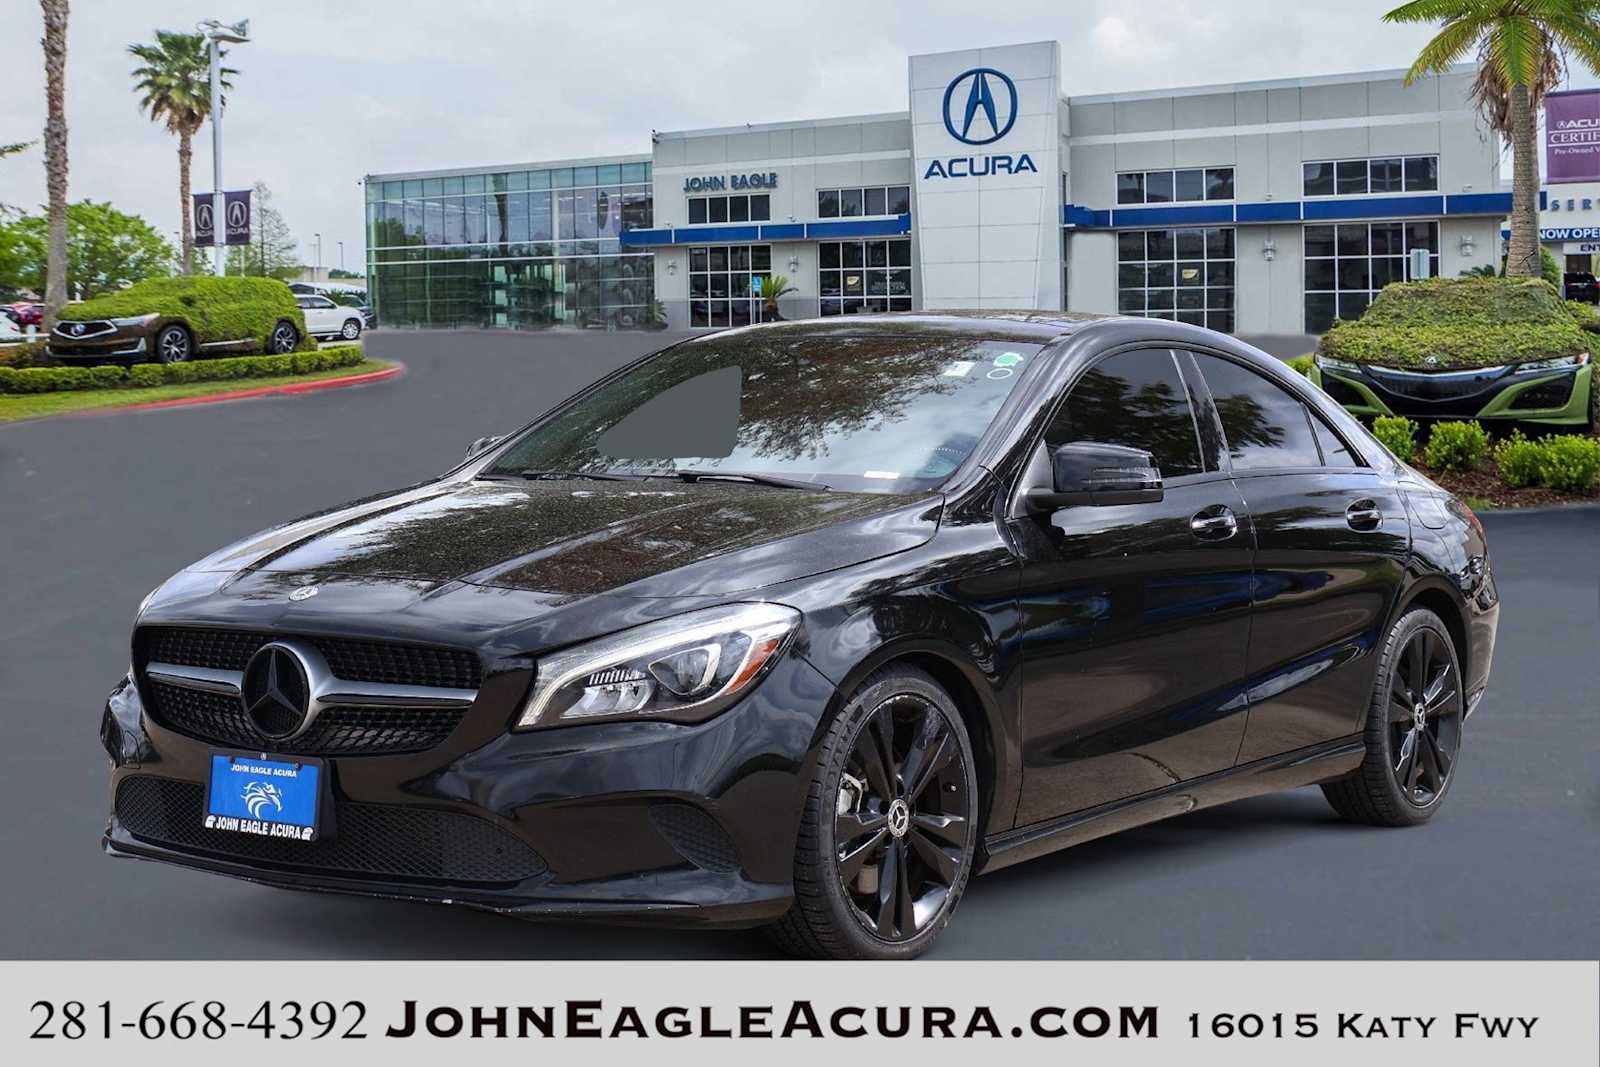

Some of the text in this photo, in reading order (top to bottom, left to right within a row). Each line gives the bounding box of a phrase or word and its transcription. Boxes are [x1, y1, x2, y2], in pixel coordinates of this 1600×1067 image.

[1566, 118, 1600, 128] ACU
[924, 154, 1038, 179] ACURA
[683, 172, 777, 192] JOHN EAGLE
[1551, 198, 1600, 211] SER
[1572, 228, 1600, 239] OPE
[231, 764, 297, 778] JOHN EAGLE ACURA
[216, 817, 301, 839] JOHN EAGLE ACURA
